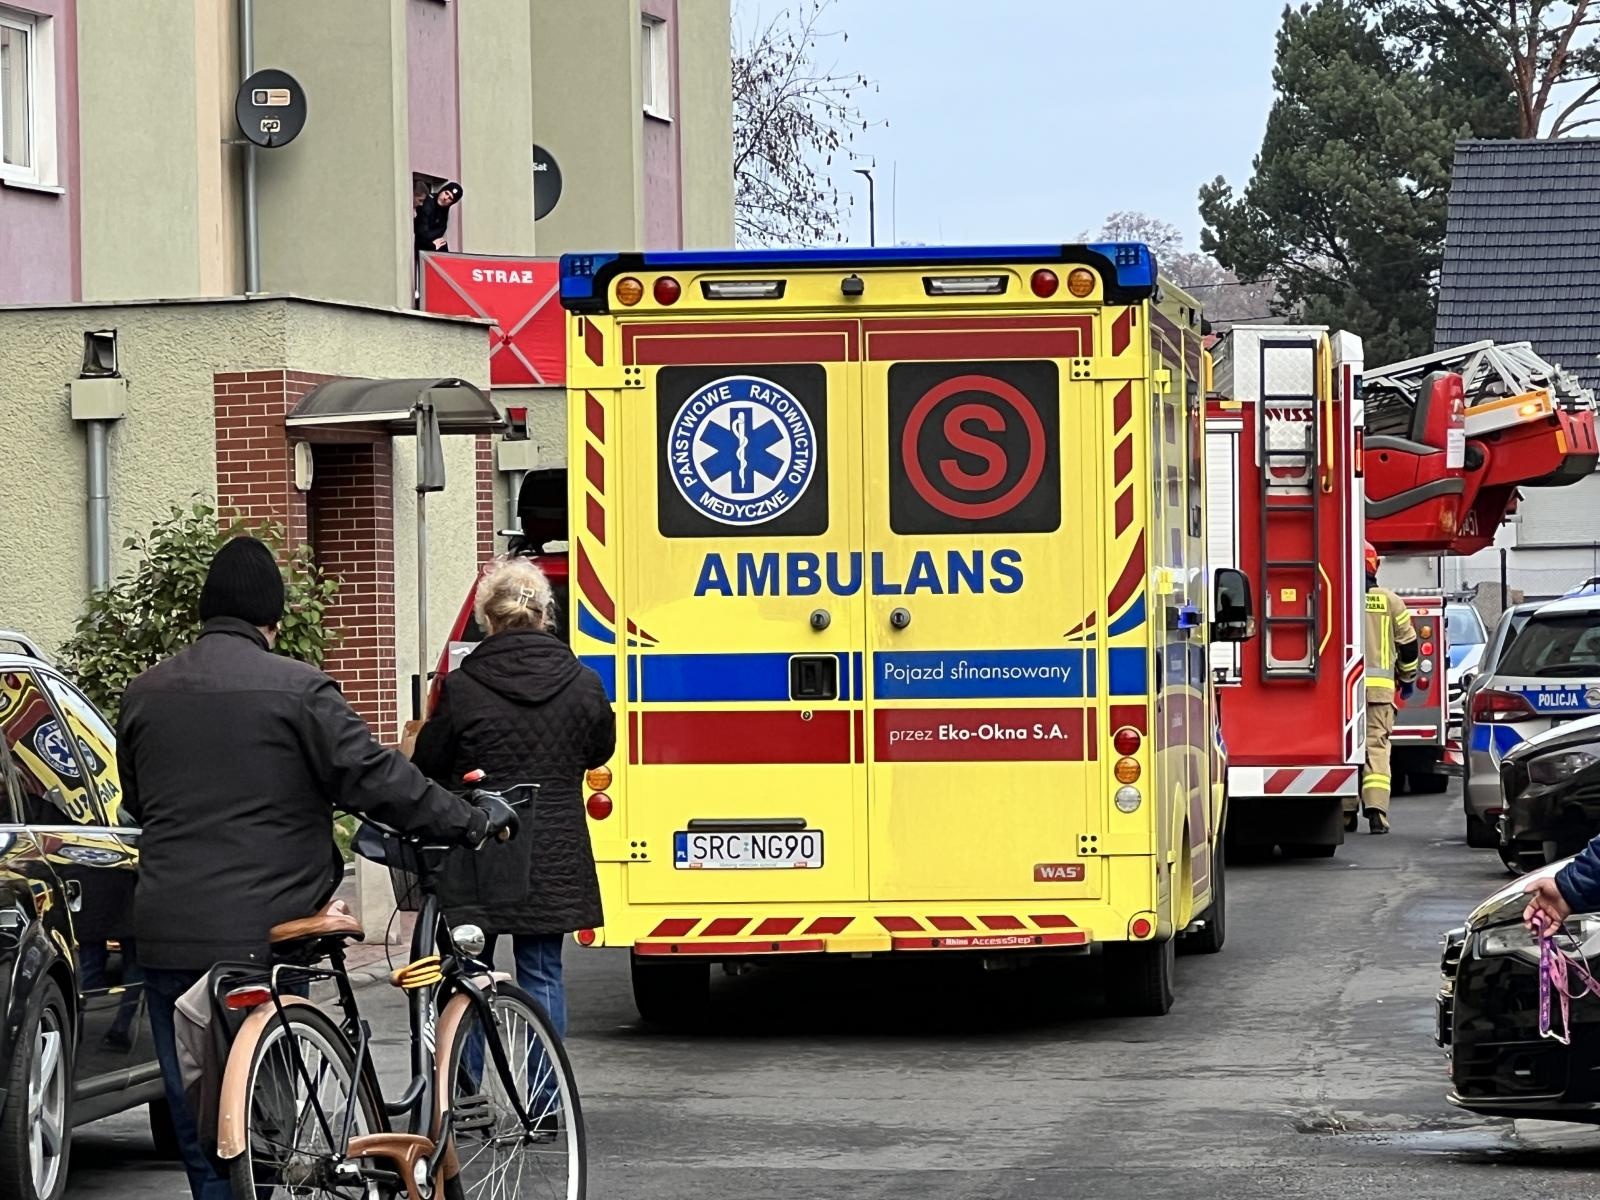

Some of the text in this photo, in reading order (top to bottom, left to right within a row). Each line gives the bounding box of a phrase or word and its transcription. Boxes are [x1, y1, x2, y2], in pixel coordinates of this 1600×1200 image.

[673, 384, 809, 488] PAŃSTWOWE RATOWNICTWO
[938, 403, 1008, 491] S
[699, 489, 789, 518] MEDYCZNE
[693, 548, 1025, 597] AMBULANS
[883, 659, 1072, 685] Pojazd sfinansowany
[1538, 692, 1579, 707] POLICJA
[889, 723, 1069, 746] przez Eko-Okna S.A.
[693, 834, 814, 860] SRC NG90
